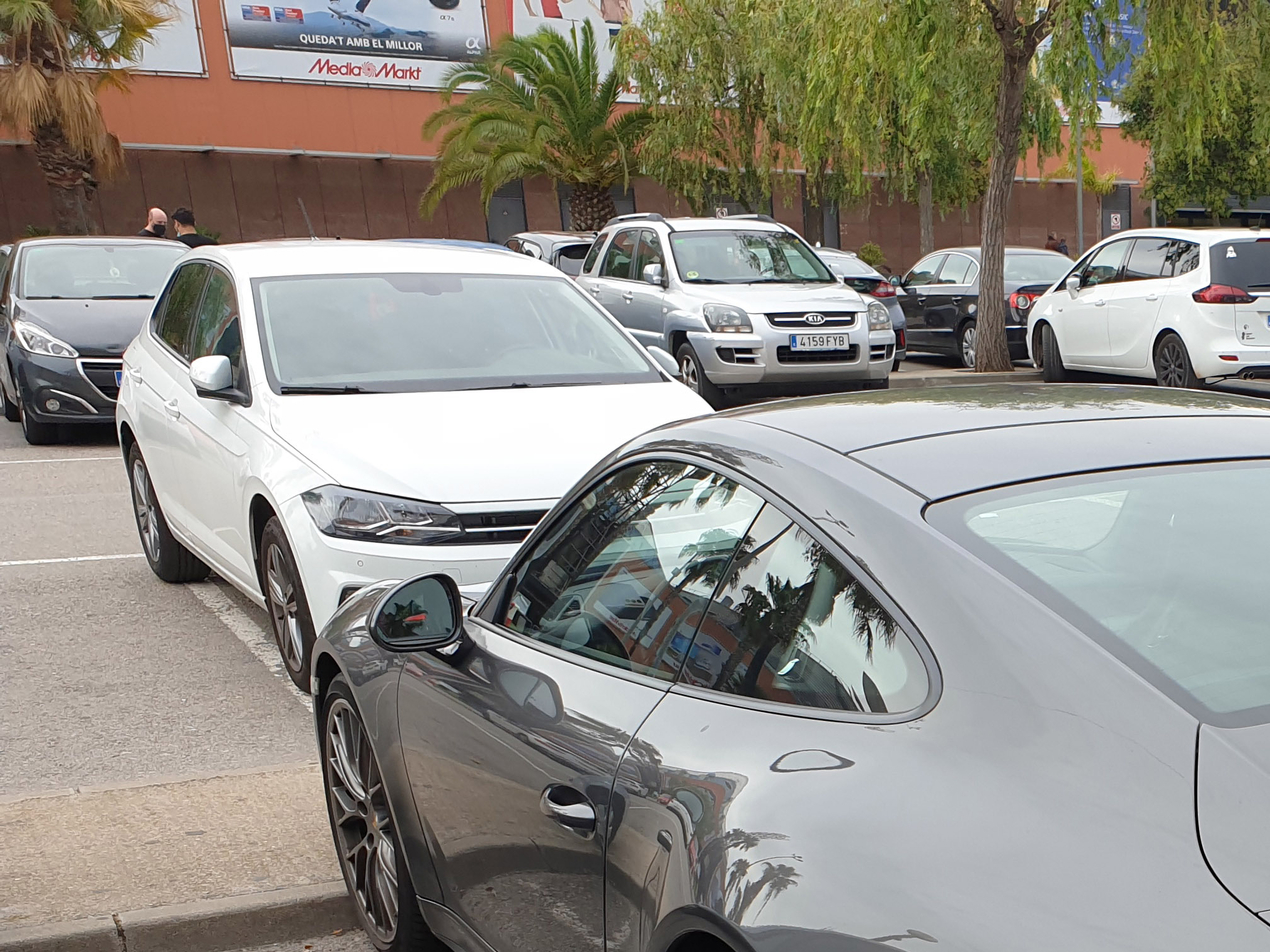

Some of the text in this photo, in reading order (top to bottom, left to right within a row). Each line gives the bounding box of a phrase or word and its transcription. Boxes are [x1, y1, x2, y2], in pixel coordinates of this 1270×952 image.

[299, 33, 423, 51] QUEDA'T AMB EL MILLOR
[800, 336, 845, 347] 4159 FYB
